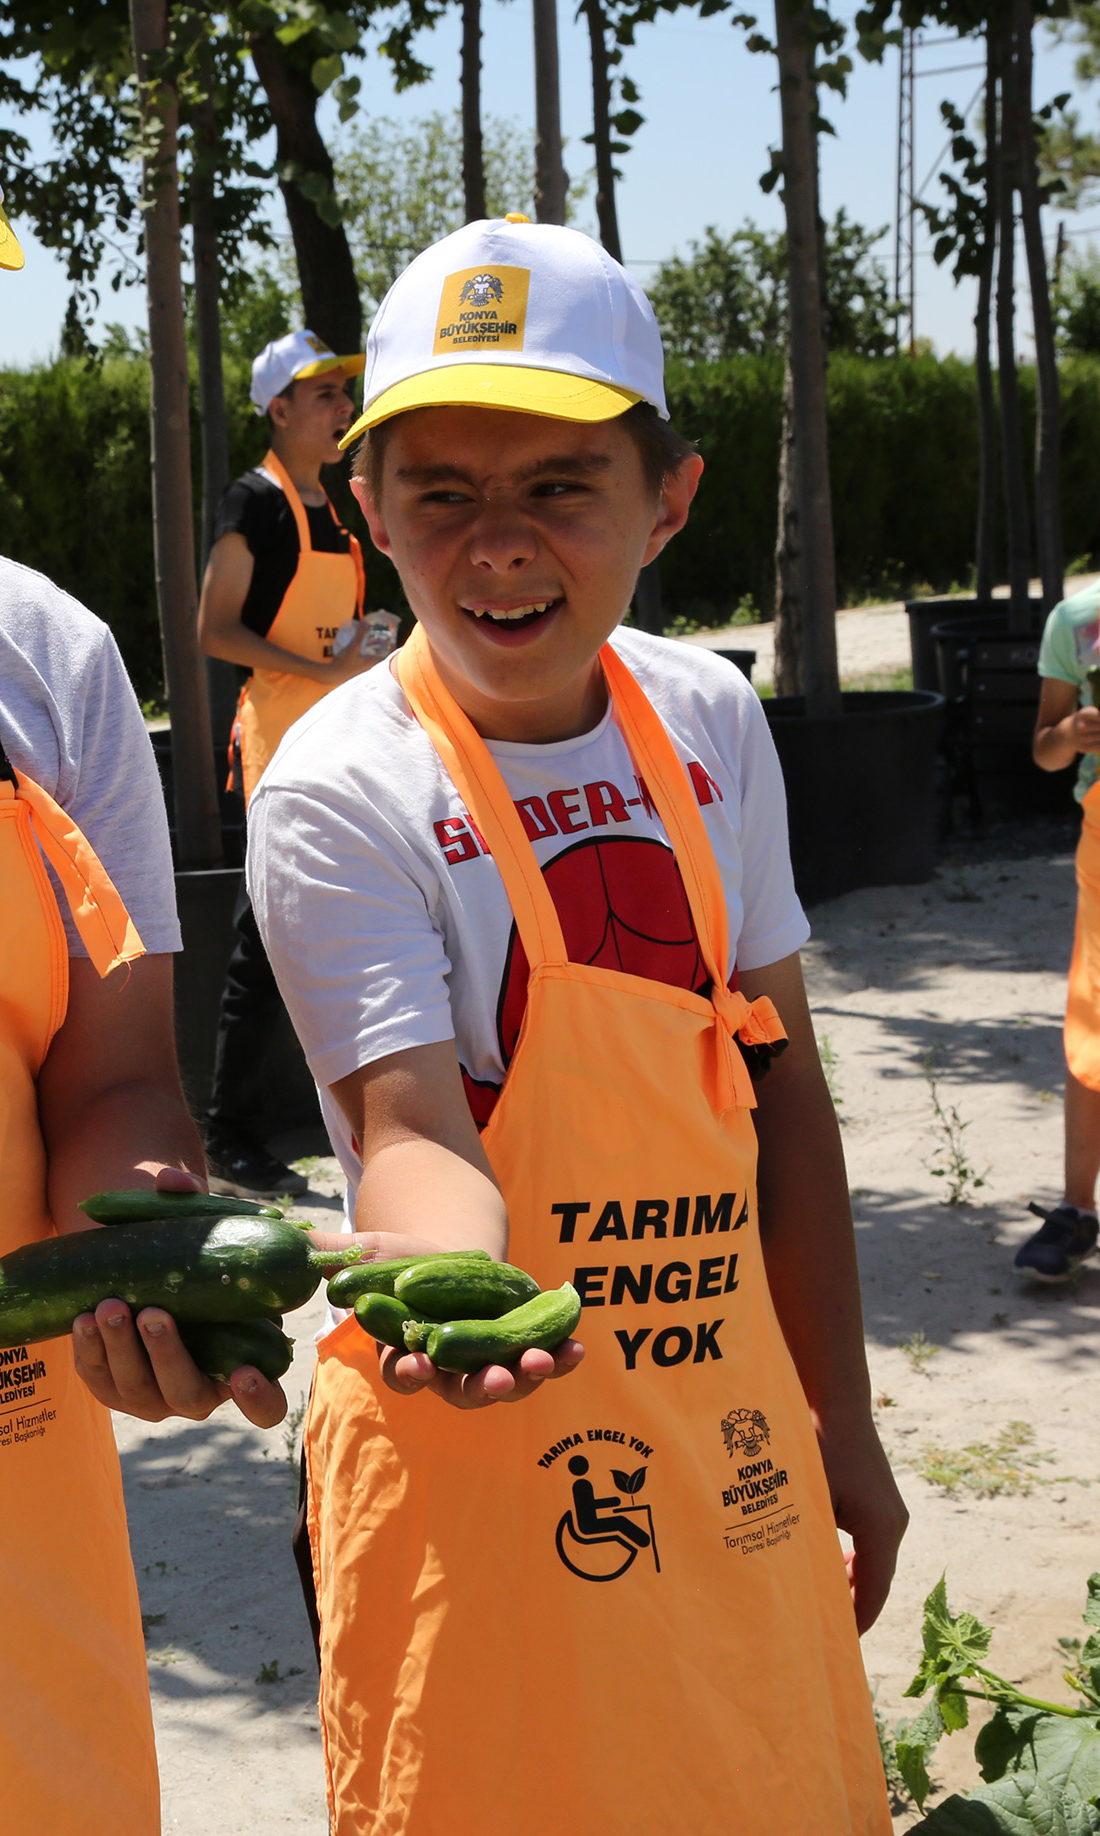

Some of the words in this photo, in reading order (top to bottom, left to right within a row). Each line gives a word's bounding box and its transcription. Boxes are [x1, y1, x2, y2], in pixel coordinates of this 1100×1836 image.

[459, 310, 498, 321] KONYA
[440, 320, 517, 339] BÜYÜKŞEHİR
[453, 334, 500, 344] BELEDİYESİ
[573, 1253, 739, 1307] ENGEL
[614, 1319, 725, 1370] YOK
[16, 1408, 57, 1431] Hizmetler
[537, 1433, 584, 1469] TARIMA
[587, 1429, 625, 1445] ENGEL
[628, 1436, 654, 1459] YOK
[737, 1458, 773, 1481] KONYA
[722, 1468, 788, 1507] BÜYÜKŞEHİR
[723, 1525, 766, 1549] Tarımsal
